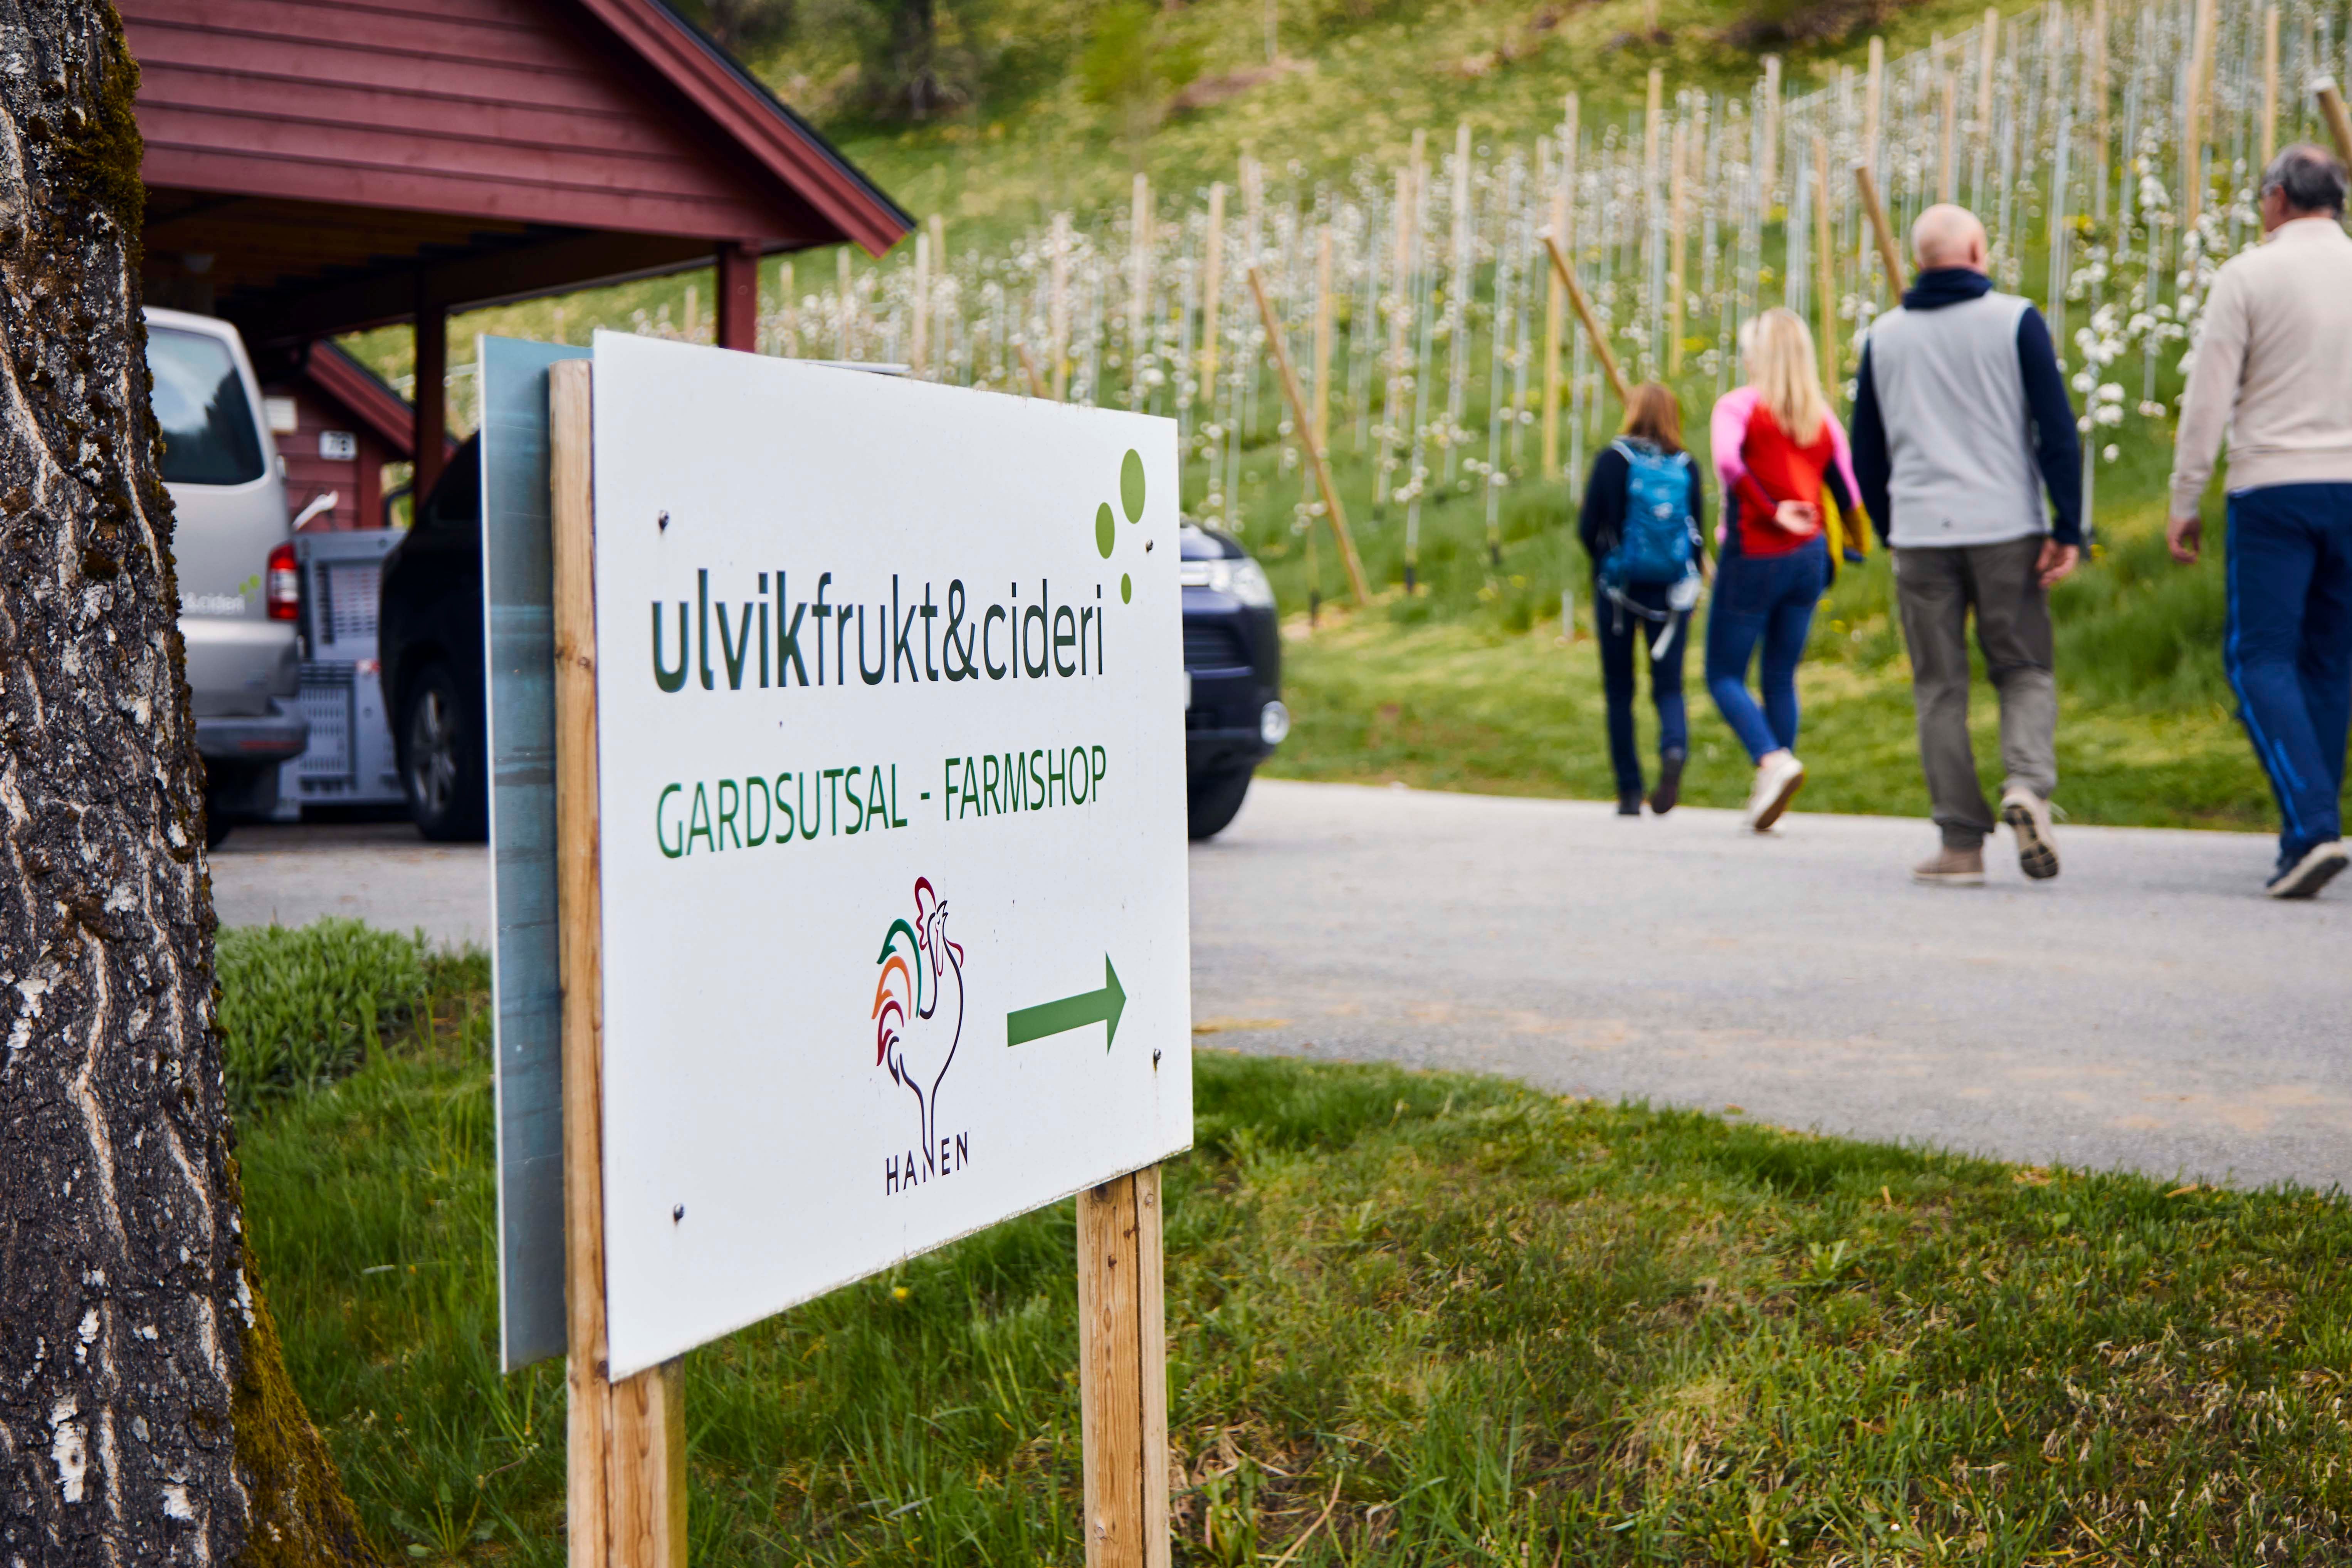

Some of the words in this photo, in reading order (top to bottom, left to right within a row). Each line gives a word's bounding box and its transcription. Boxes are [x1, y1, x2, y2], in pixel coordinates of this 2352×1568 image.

[651, 567, 1103, 693] ulvikfrukt&cideri
[657, 763, 908, 859] GARDSUTSAL
[921, 791, 931, 801] -
[945, 744, 1107, 821] FARMSHOP
[886, 1131, 968, 1196] HANEN
